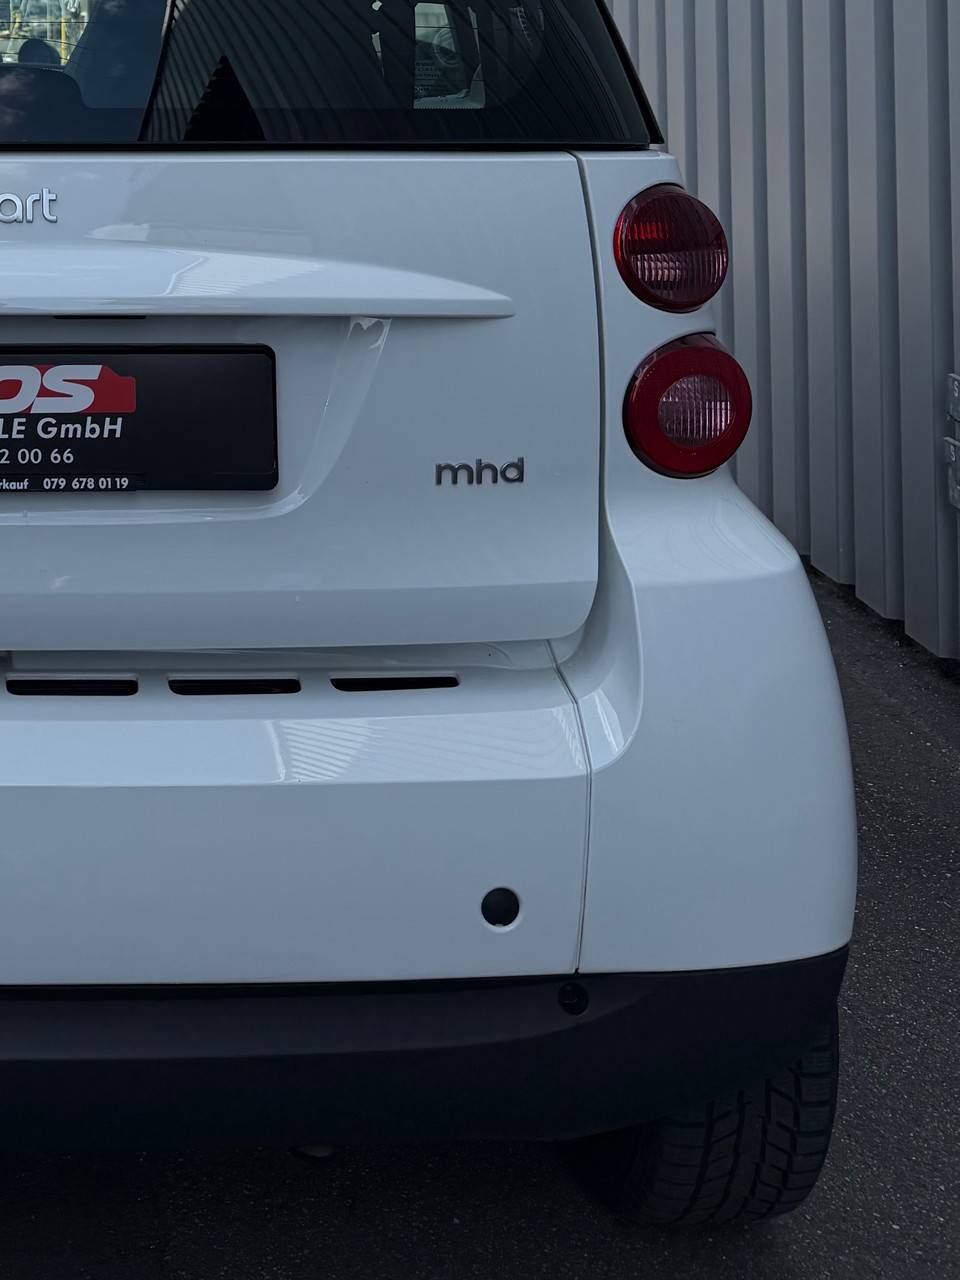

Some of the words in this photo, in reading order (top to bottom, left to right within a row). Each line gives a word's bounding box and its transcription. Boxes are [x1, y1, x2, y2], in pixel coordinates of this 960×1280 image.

[37, 417, 123, 439] GmbH
[17, 449, 42, 464] 00
[50, 448, 74, 464] 66
[435, 457, 525, 485] mhd
[43, 477, 66, 490] 079
[71, 477, 95, 490] 678
